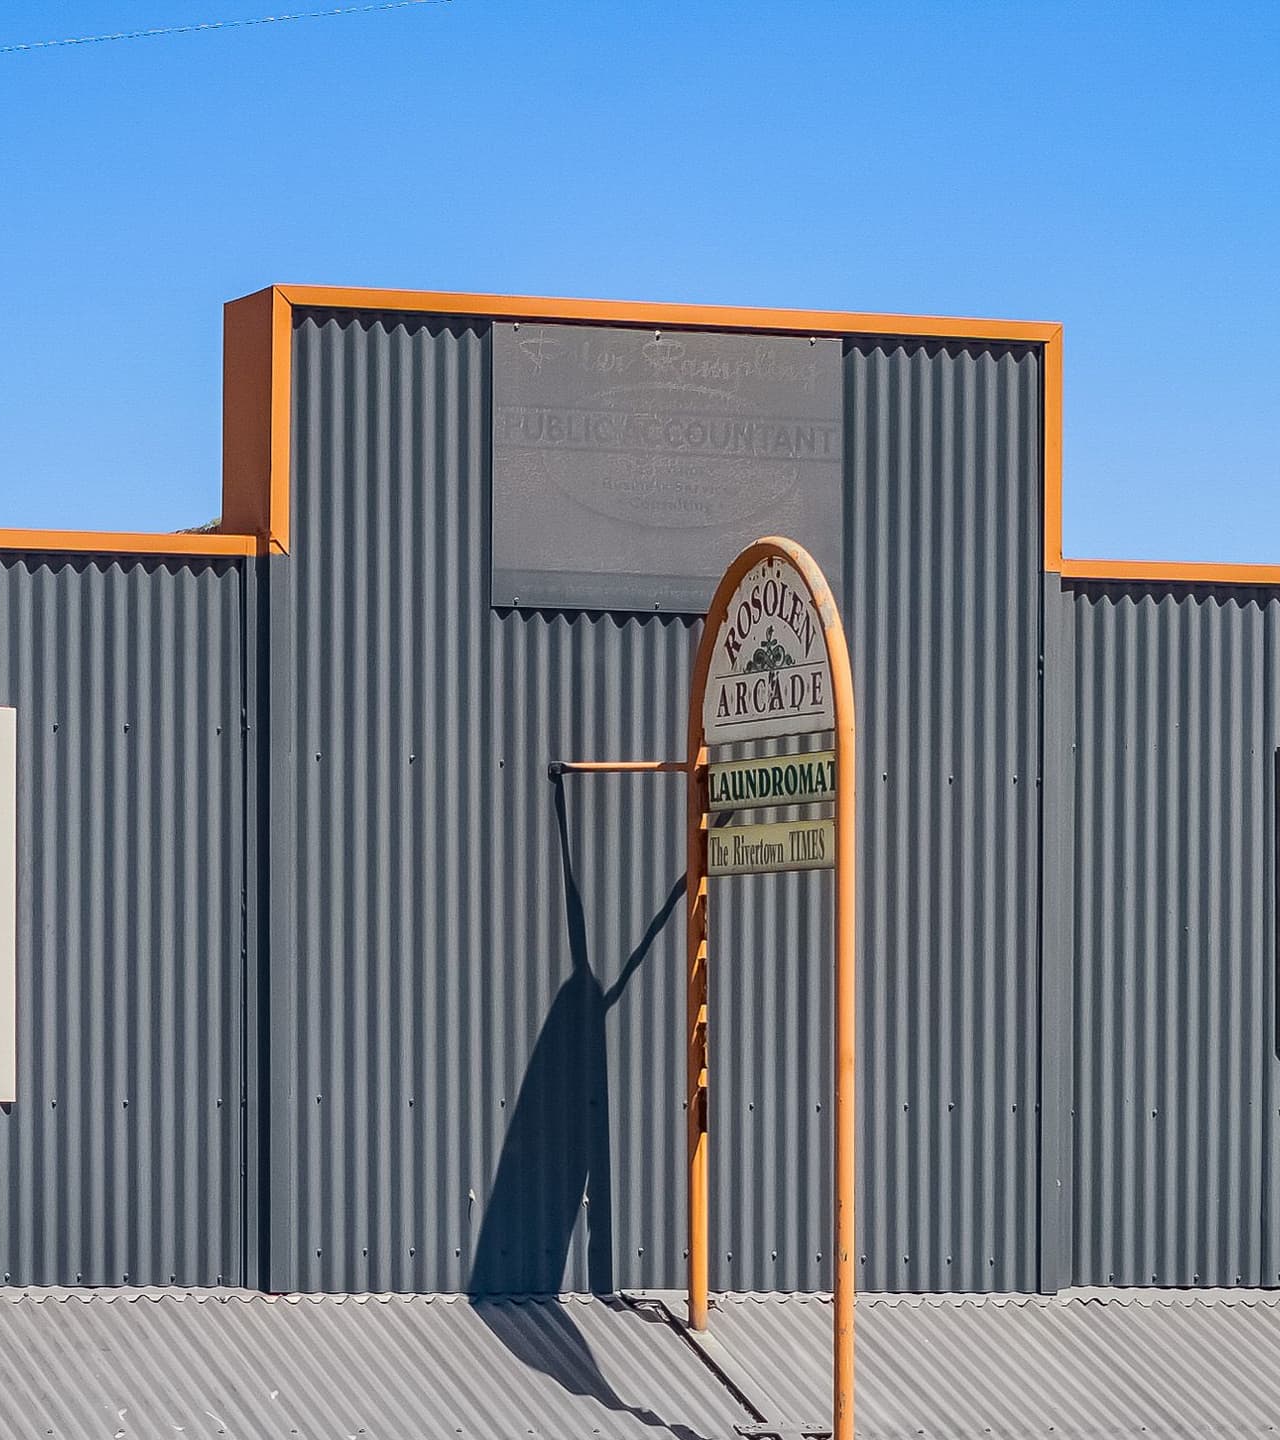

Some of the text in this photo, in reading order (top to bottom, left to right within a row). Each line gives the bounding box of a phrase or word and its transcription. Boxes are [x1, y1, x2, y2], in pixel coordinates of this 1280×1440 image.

[724, 578, 816, 664] ROSOLEN
[716, 670, 824, 718] ARCADE
[709, 761, 836, 802] LAUNDROMAT
[710, 828, 825, 867] The Rivertown TIMES
